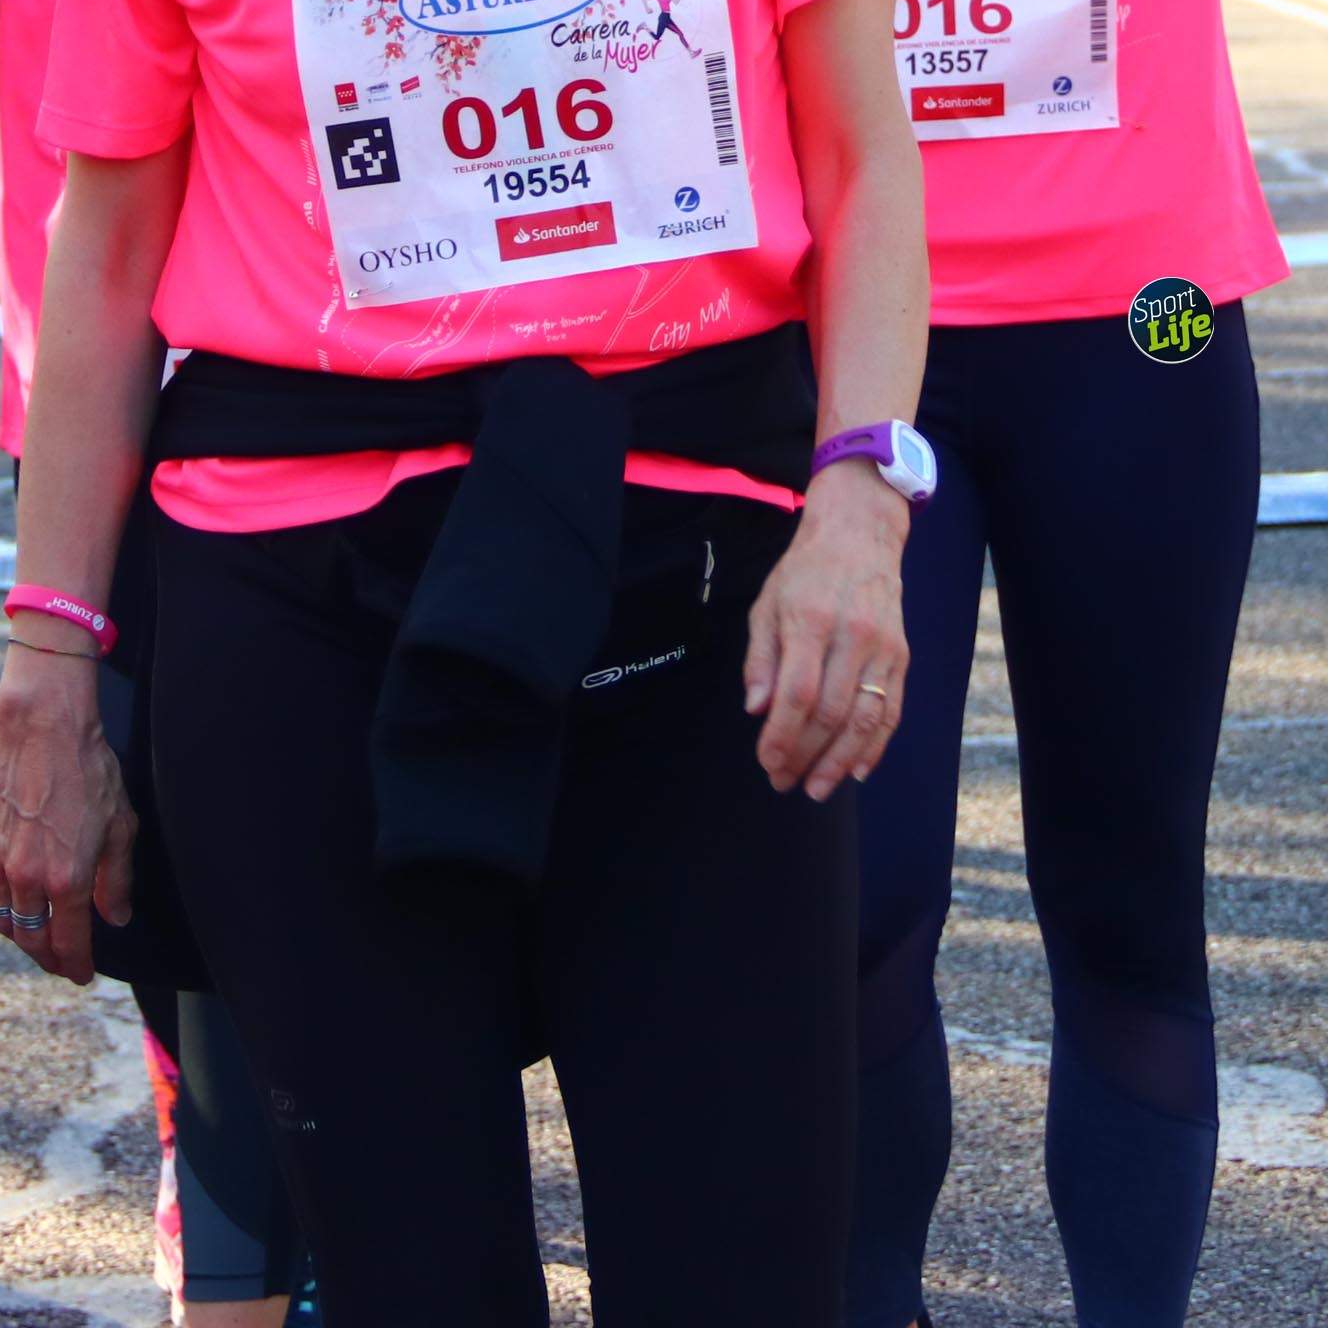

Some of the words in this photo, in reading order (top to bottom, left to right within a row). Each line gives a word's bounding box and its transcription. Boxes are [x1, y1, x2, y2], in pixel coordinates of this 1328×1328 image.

[550, 19, 631, 47] Carrera
[574, 47, 589, 62] de
[591, 45, 603, 60] la
[603, 33, 663, 73] Mujer
[905, 49, 989, 76] 13557
[938, 96, 993, 110] Santander
[1037, 100, 1092, 115] ZURICH
[441, 77, 615, 161] 016
[506, 152, 558, 167] VIOLENCIA
[559, 150, 572, 159] DE
[484, 159, 591, 203] 19554
[532, 220, 600, 241] Santander
[658, 215, 727, 239] ZURICH
[359, 238, 458, 272] OYSHO
[649, 321, 692, 353] City
